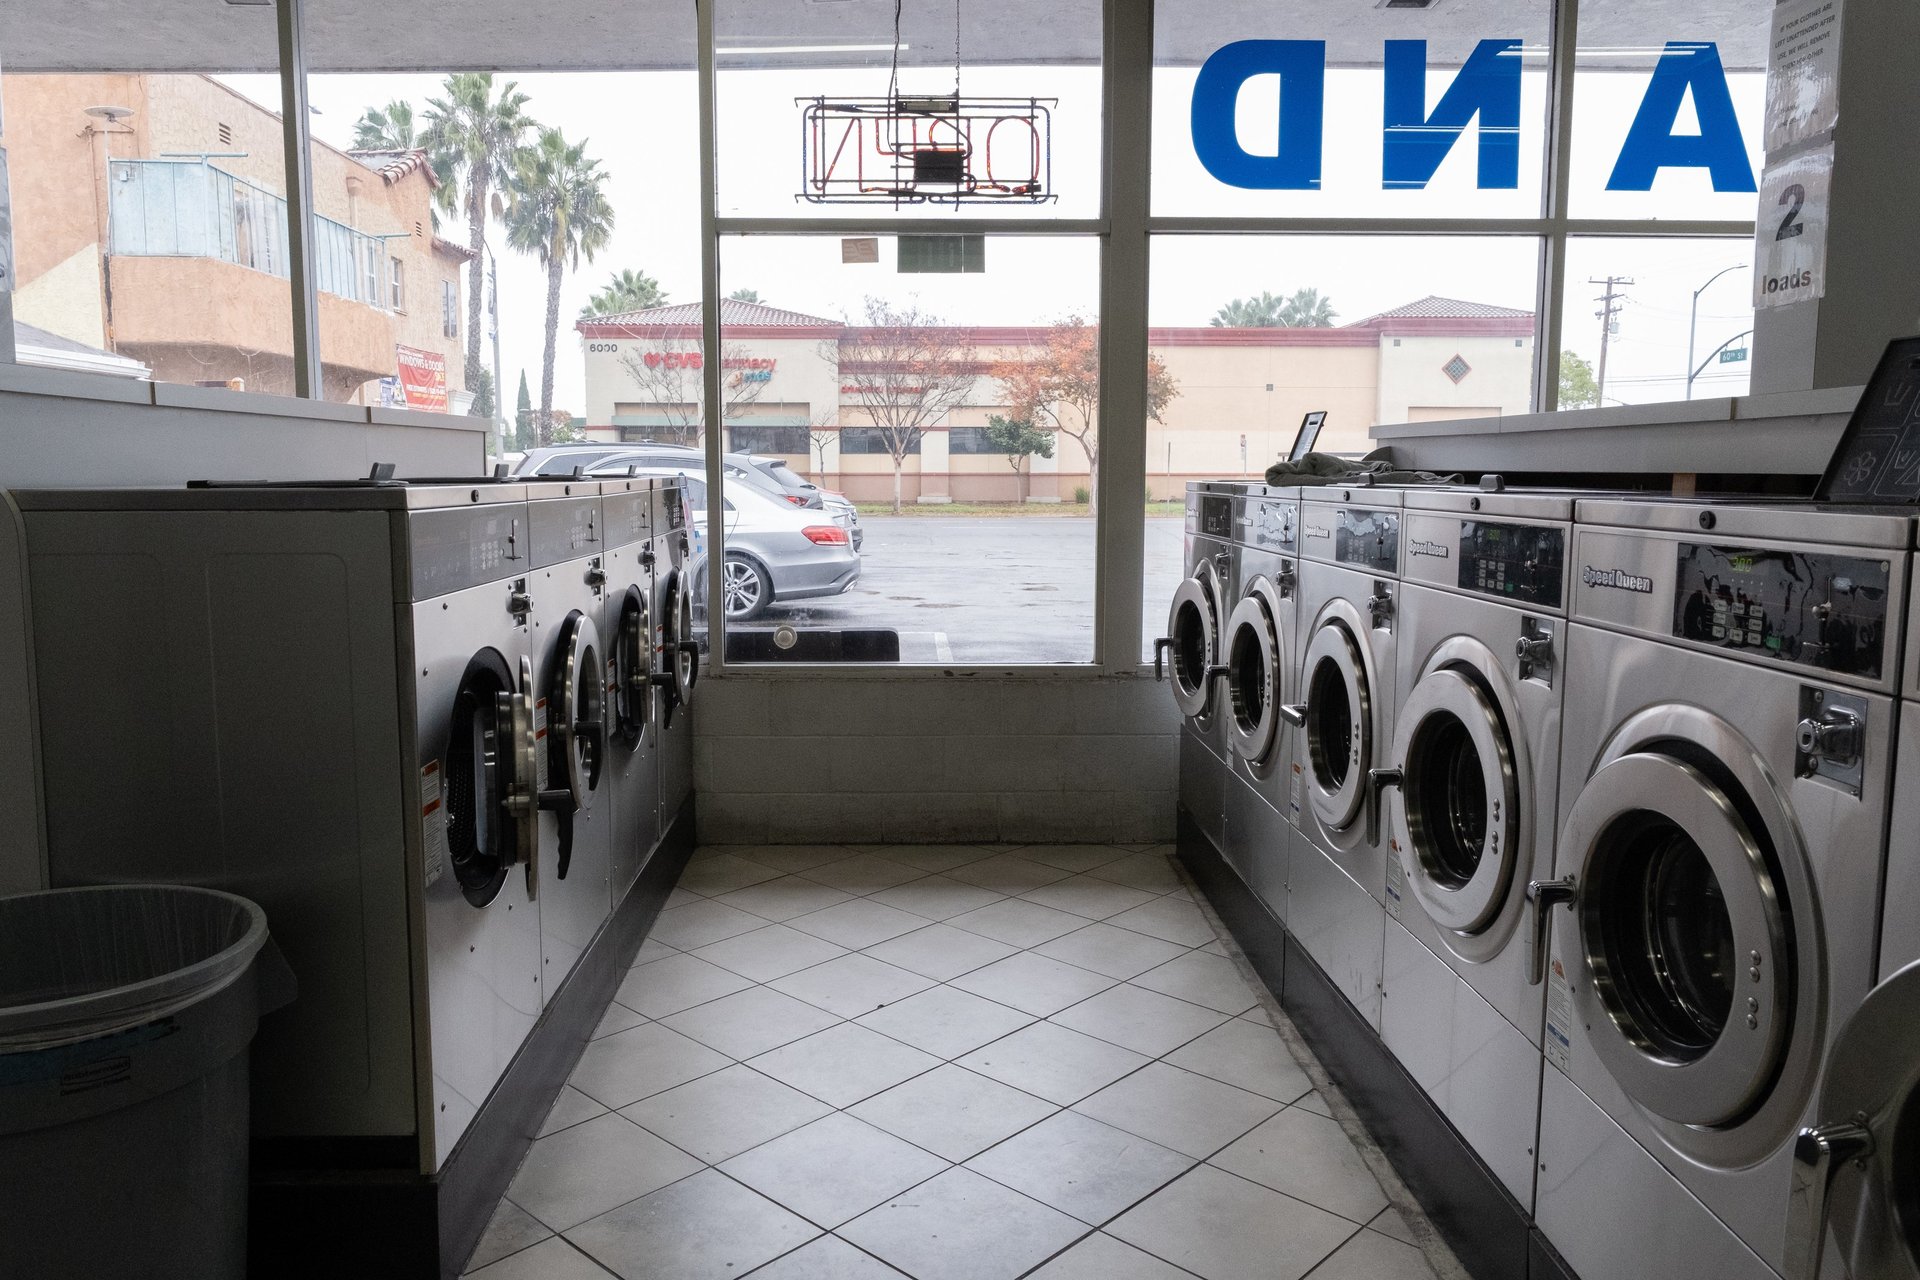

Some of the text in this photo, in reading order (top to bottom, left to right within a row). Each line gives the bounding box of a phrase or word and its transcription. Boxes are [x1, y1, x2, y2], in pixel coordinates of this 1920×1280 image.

[1786, 18, 1799, 30] YOUR
[1800, 7, 1821, 24] CLOTHES
[1822, 2, 1833, 13] ARE
[1786, 22, 1819, 43] UNATTENDED
[1820, 14, 1836, 28] AFTER
[1809, 30, 1831, 46] REMOVE
[1775, 183, 1806, 242] 2
[1762, 267, 1811, 295] loads
[589, 343, 618, 353] 6000
[663, 352, 704, 370] CVS
[1409, 539, 1449, 559] Speed Queen
[1583, 565, 1653, 593] Speed Queen
